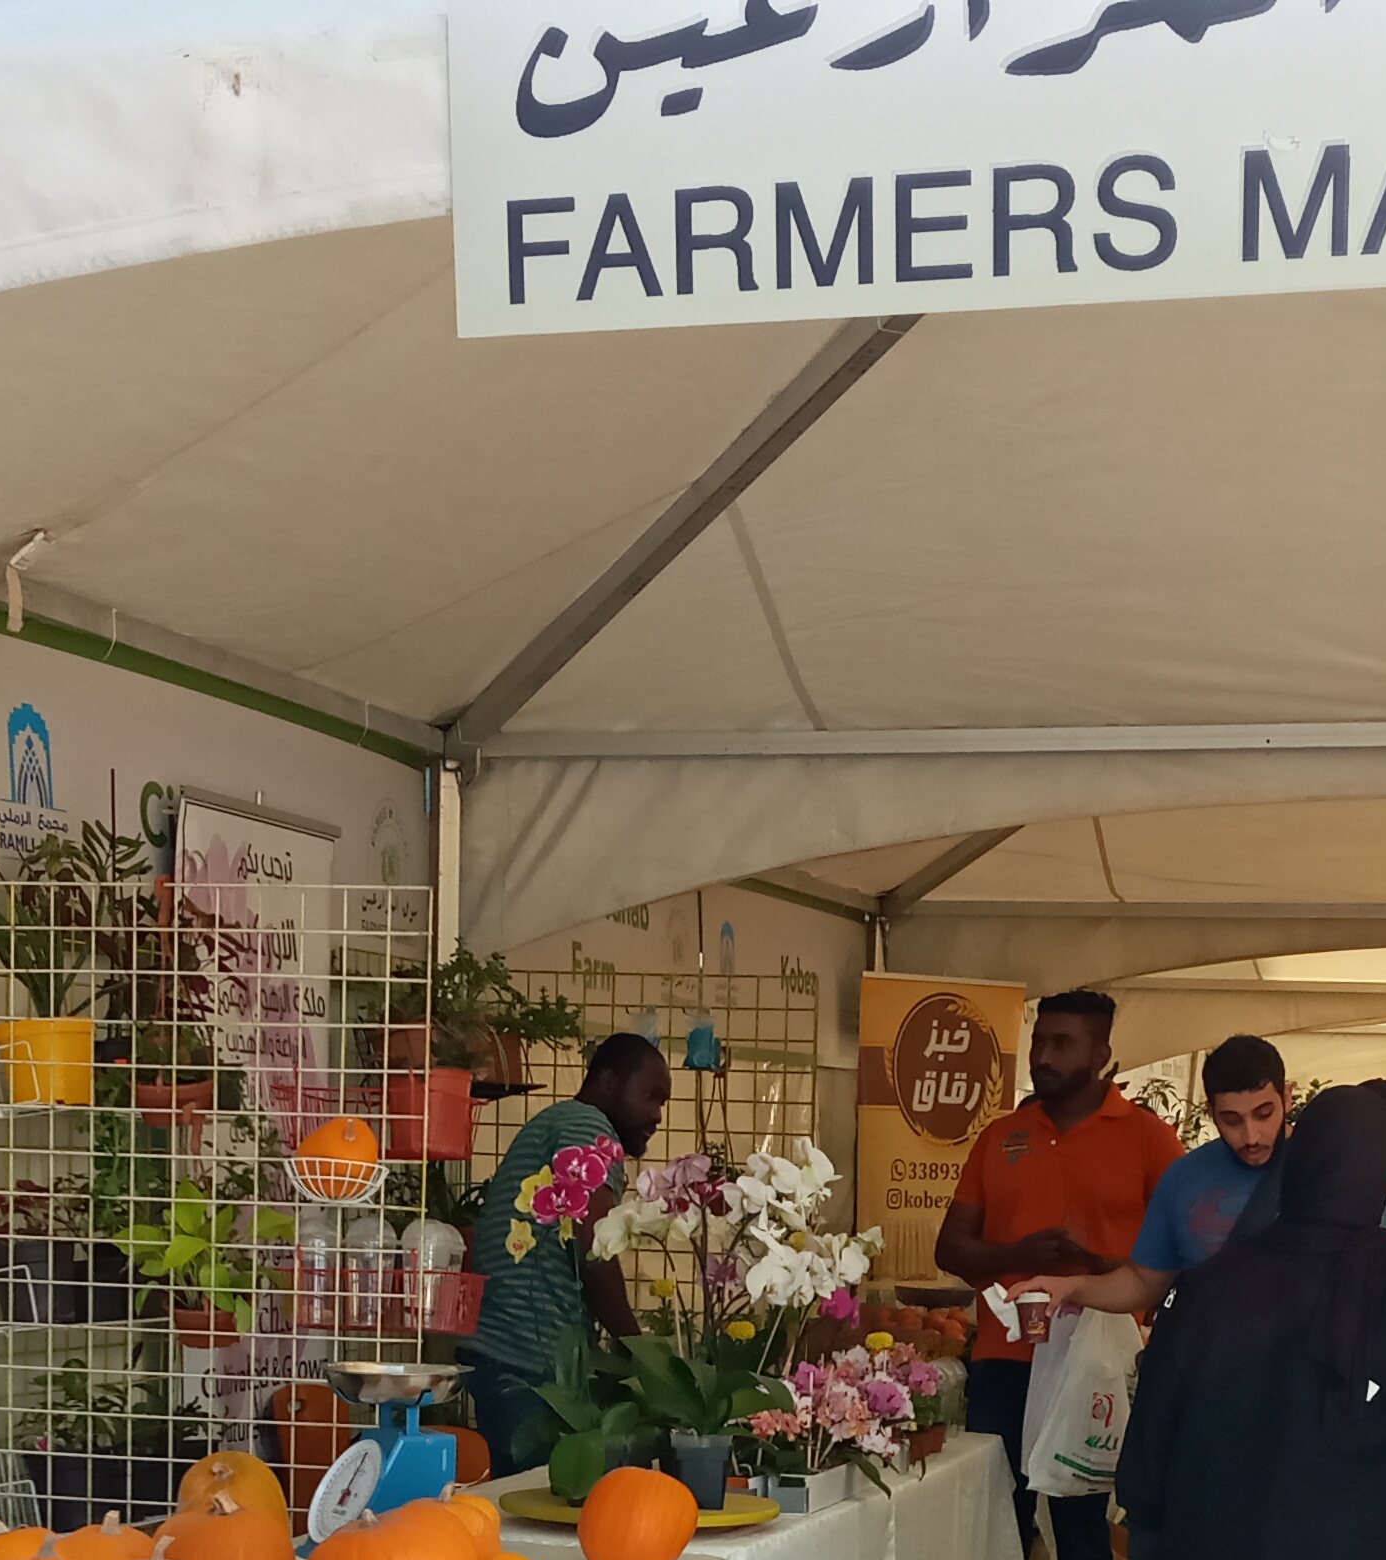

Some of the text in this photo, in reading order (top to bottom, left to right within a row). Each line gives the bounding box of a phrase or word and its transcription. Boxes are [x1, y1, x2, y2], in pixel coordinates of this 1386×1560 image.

[507, 152, 1178, 305] FARMERS
[572, 940, 616, 992] Farm
[924, 1018, 970, 1062] خبز
[912, 1071, 982, 1113] رقاق
[909, 1162, 963, 1181] 33893
[904, 1189, 954, 1209] kobez
